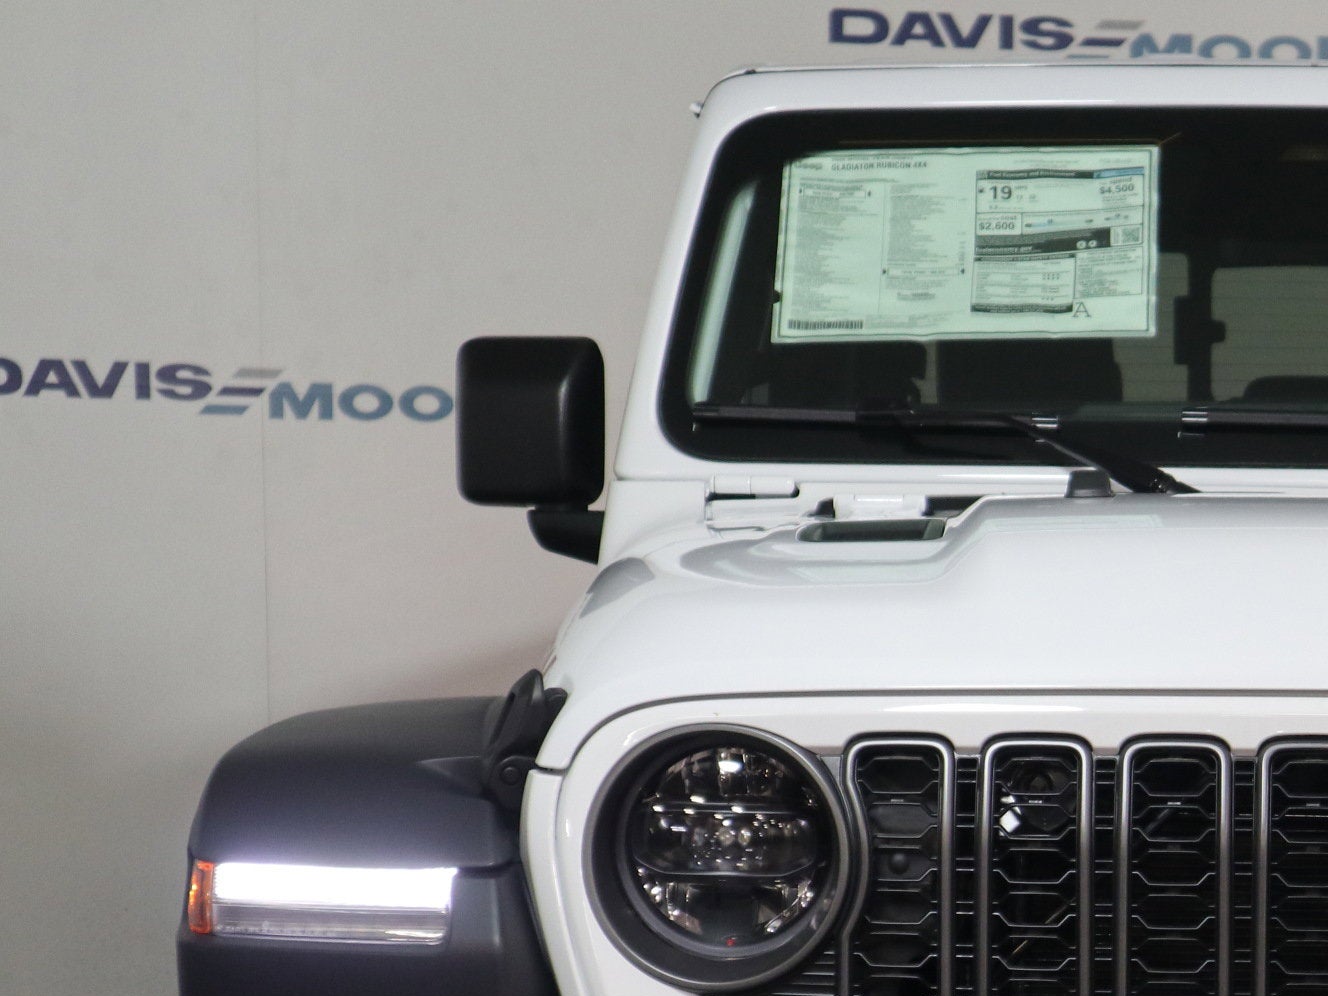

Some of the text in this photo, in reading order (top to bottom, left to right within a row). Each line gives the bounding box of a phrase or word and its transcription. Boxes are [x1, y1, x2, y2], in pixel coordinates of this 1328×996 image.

[829, 8, 1074, 51] DAVIS
[831, 162, 874, 171] GLADIATOR
[876, 161, 911, 169] RUBICON
[989, 185, 1012, 200] 19
[978, 221, 1015, 231] $2,600
[1073, 301, 1091, 318] A
[268, 381, 454, 422] MOO
